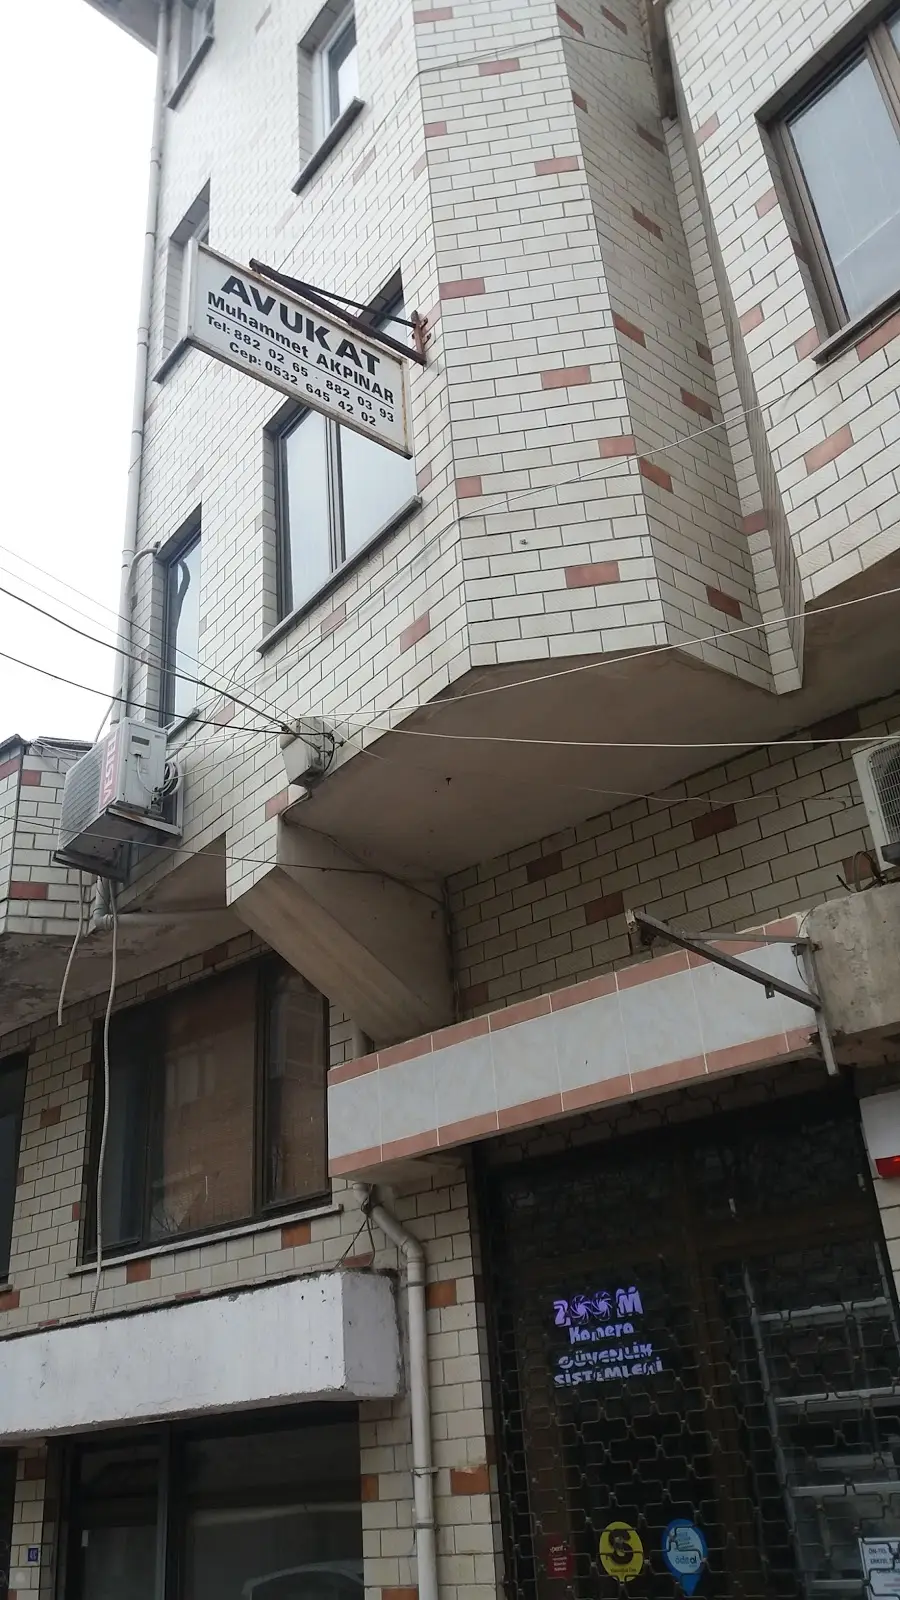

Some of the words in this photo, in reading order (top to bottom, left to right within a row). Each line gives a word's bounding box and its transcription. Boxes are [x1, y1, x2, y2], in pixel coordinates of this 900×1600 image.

[207, 291, 309, 359] Muhammet
[316, 353, 394, 405] AKPINAR
[220, 275, 380, 376] AVUKAT
[233, 329, 261, 350] 882
[268, 348, 285, 364] 02
[292, 362, 308, 377] 65
[325, 380, 350, 399] 882
[357, 396, 373, 410] 03
[379, 407, 394, 423] 93
[265, 360, 298, 386] 0532
[305, 383, 330, 402] 645
[338, 400, 354, 415] 42
[361, 412, 377, 427] 02
[553, 1286, 643, 1327] ZOOM
